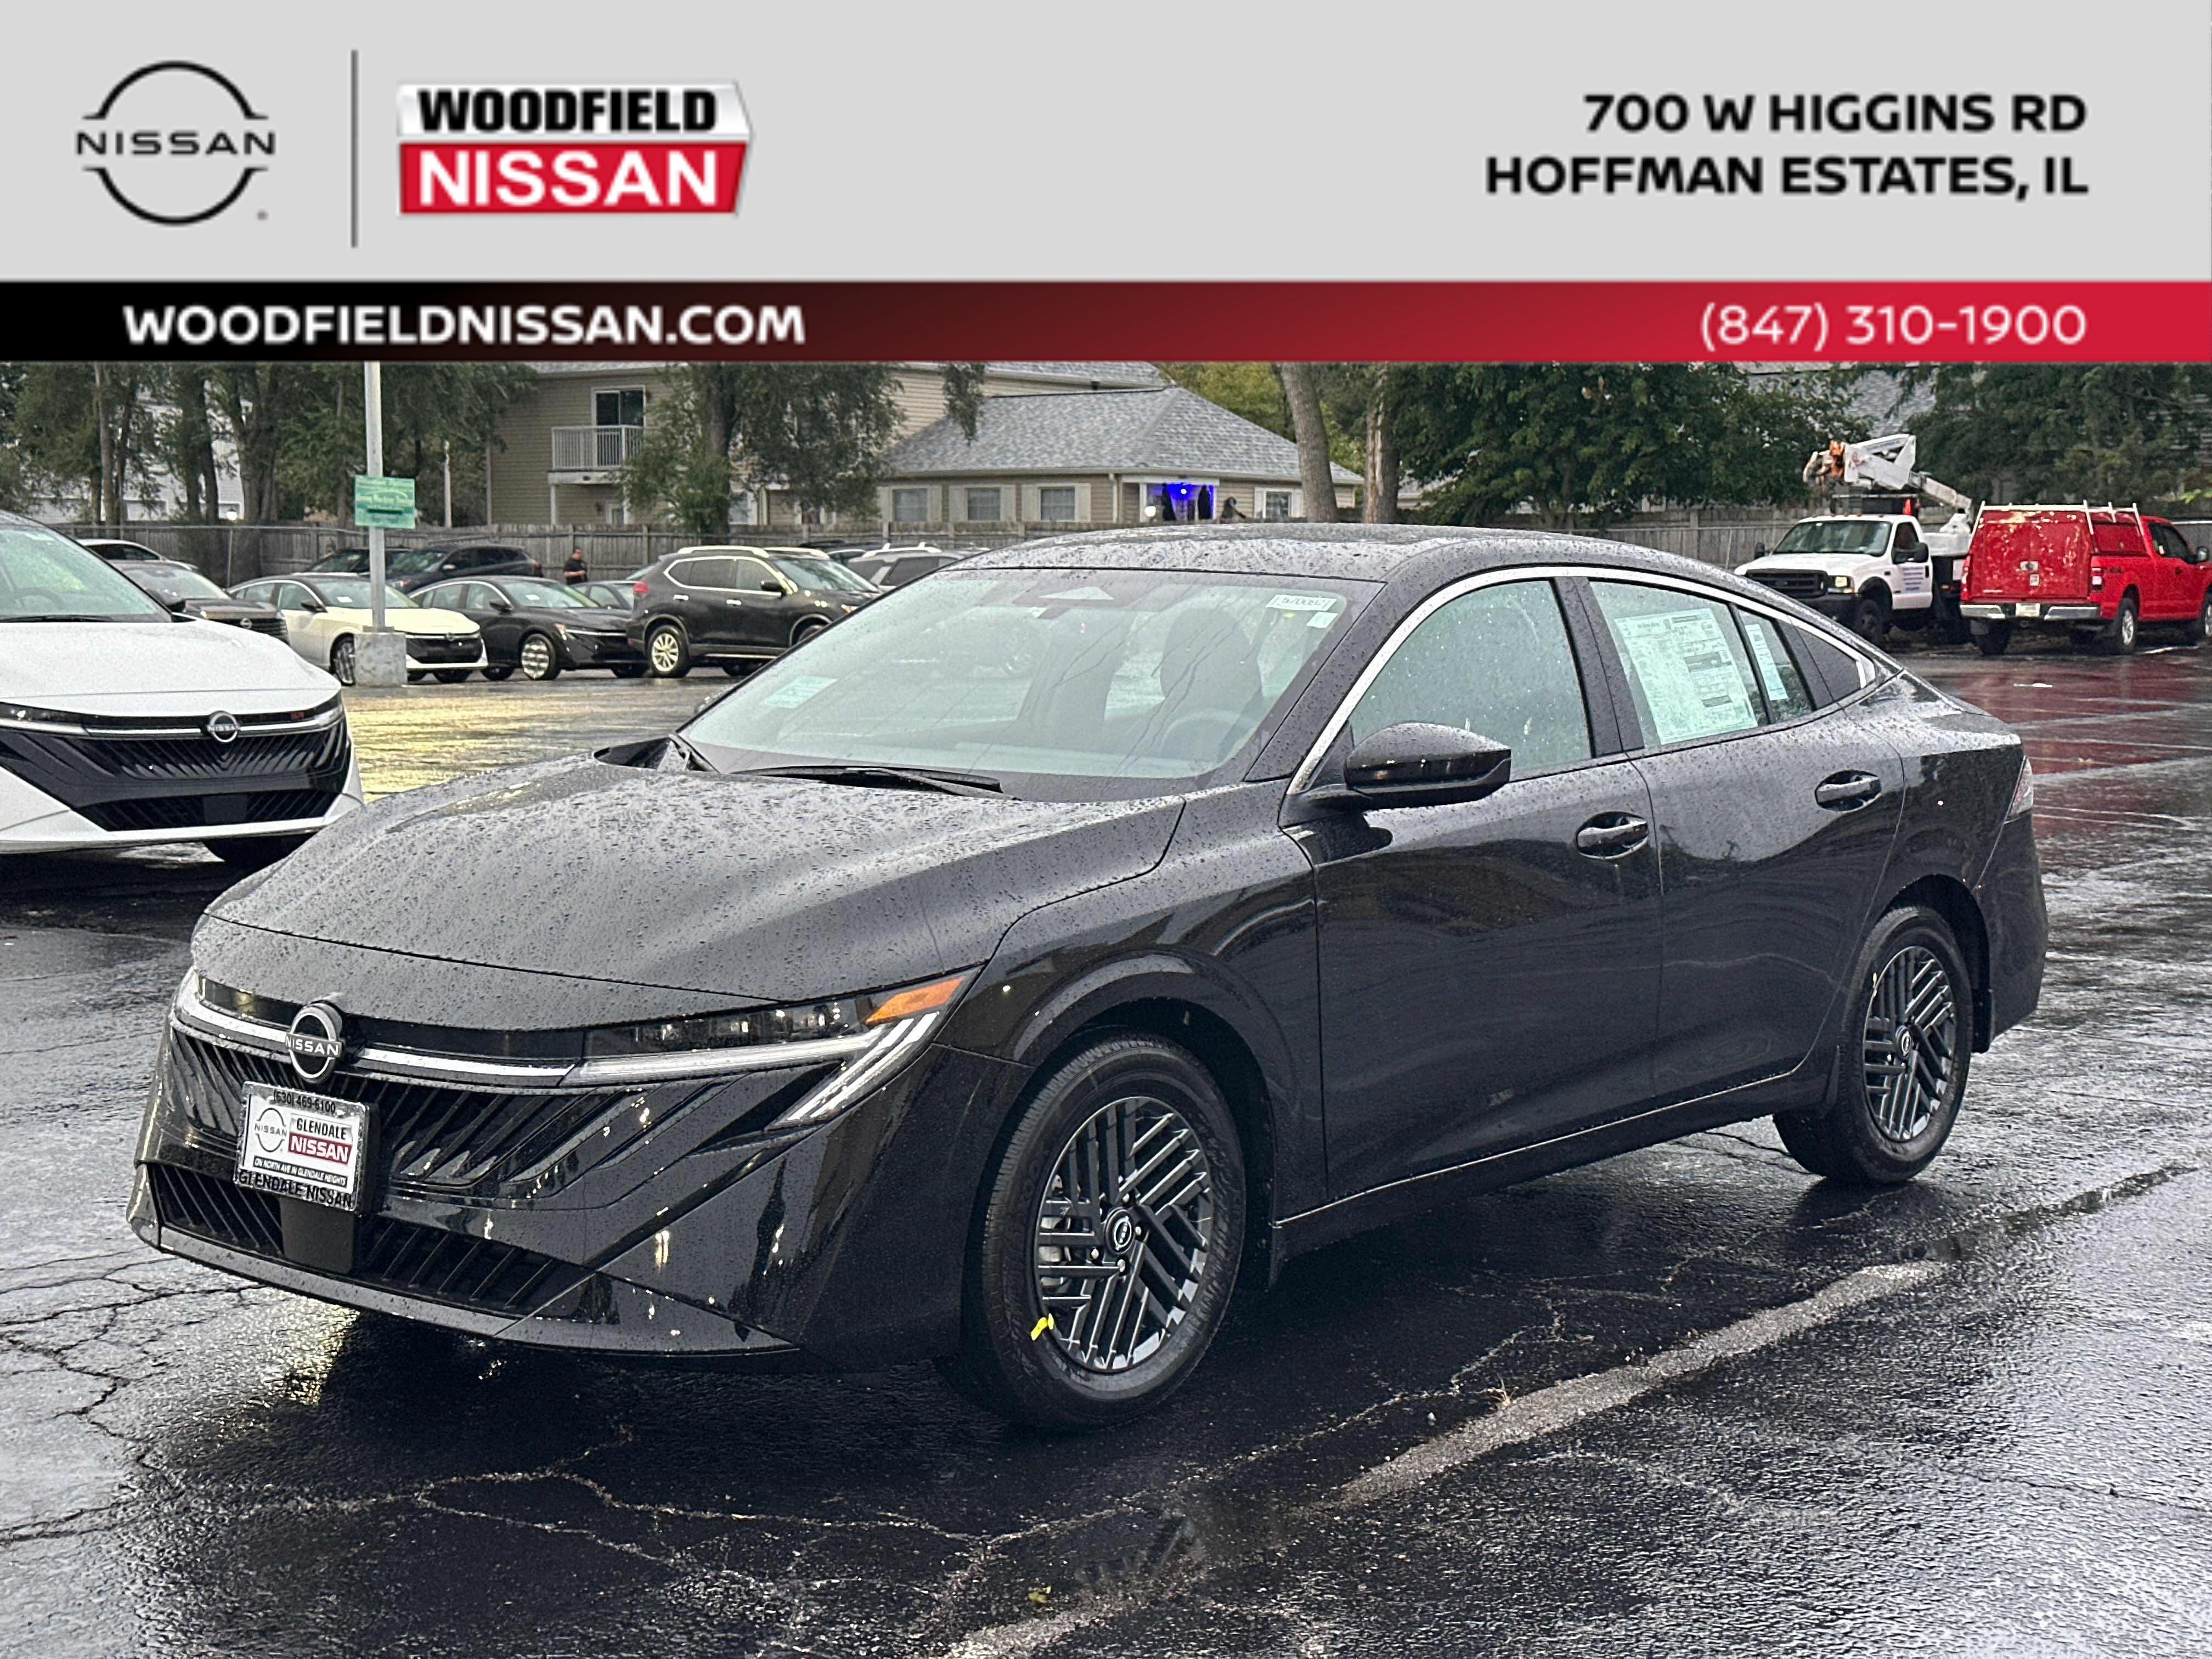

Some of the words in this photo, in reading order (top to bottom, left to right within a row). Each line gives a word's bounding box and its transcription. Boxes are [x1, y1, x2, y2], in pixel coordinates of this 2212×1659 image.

[285, 1035, 339, 1056] NISSAN
[274, 1088, 295, 1106] (630)
[297, 1096, 336, 1113] 469-6100
[254, 1124, 287, 1137] NISSAN
[296, 1118, 348, 1140] GLENDALE
[290, 1136, 349, 1163] NISSAN
[254, 1158, 263, 1167] ON
[263, 1159, 281, 1171] NORTH
[280, 1163, 291, 1173] AVE
[297, 1167, 325, 1181] GLENDALE
[239, 1170, 302, 1195] GLENDALE
[306, 1184, 352, 1207] NISSAN
